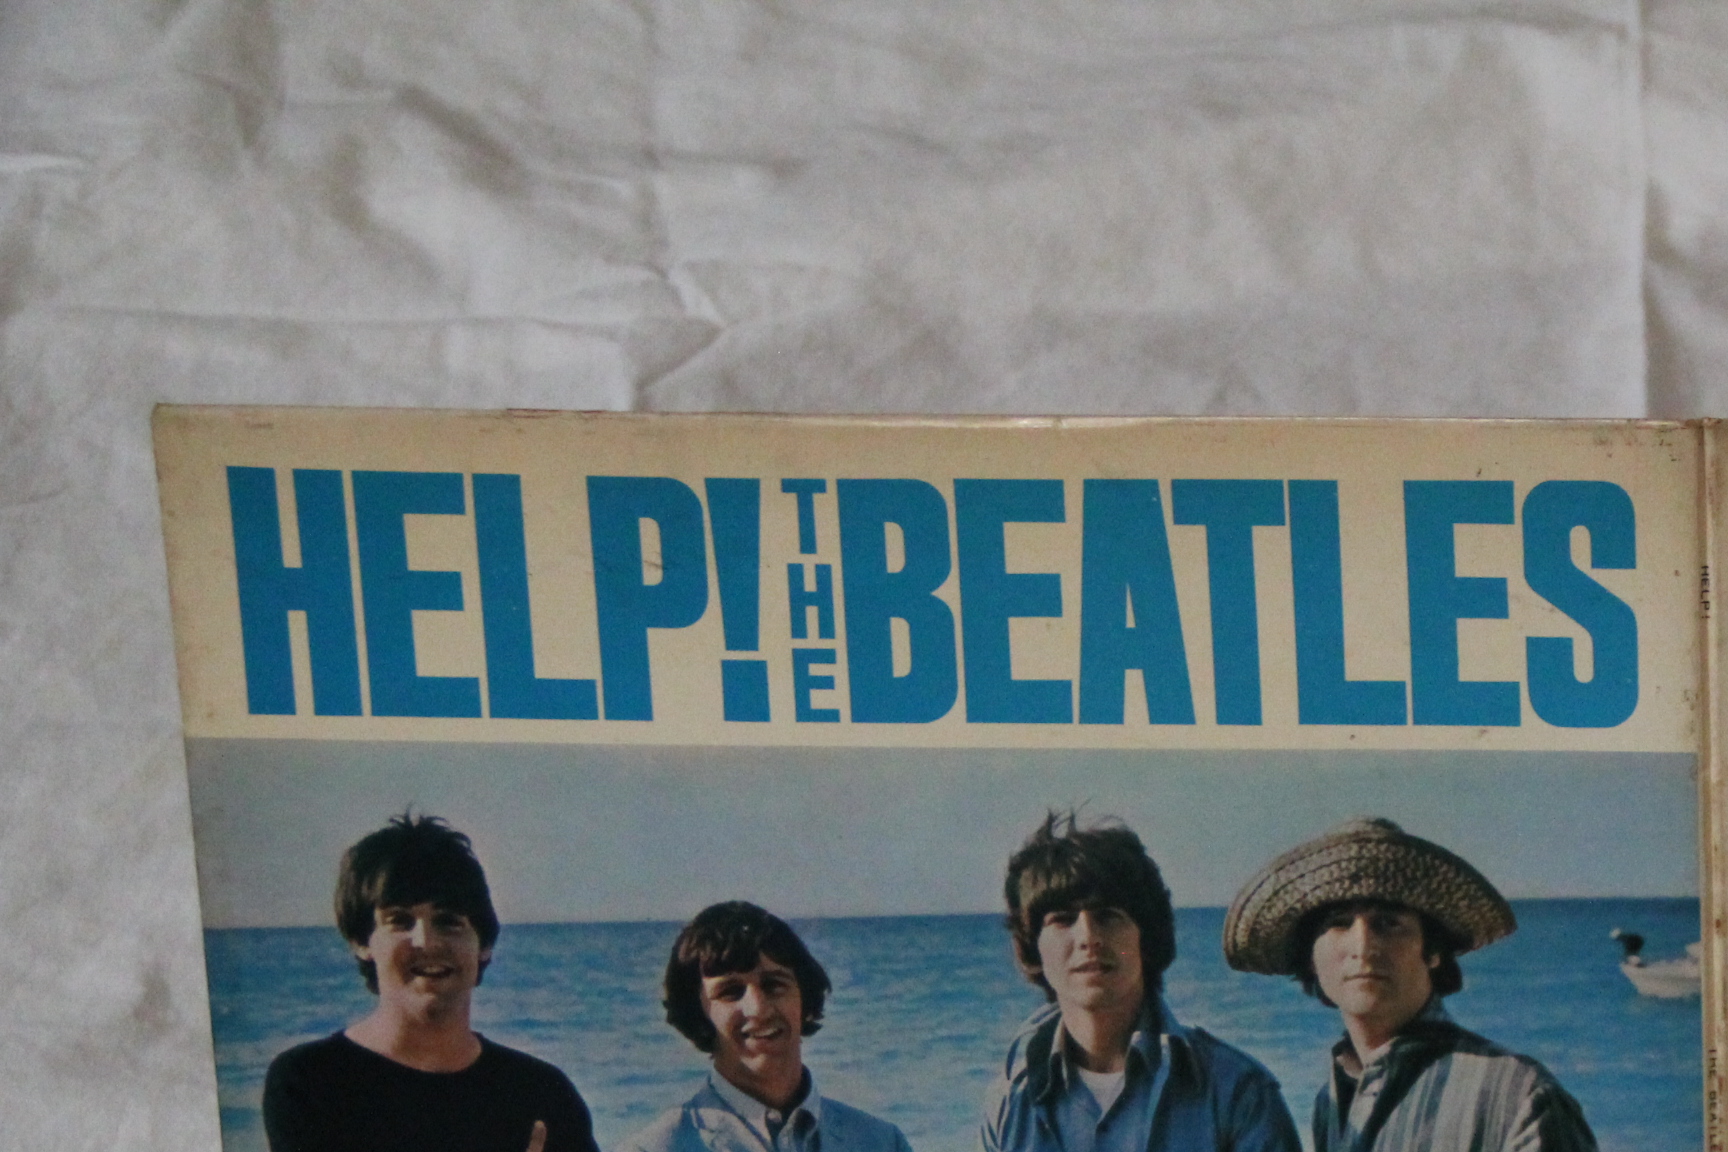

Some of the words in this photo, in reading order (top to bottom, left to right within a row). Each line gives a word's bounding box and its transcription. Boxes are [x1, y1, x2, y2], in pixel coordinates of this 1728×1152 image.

[226, 465, 771, 723] HELP!
[781, 478, 841, 723] THE
[835, 478, 1640, 728] BEATLES
